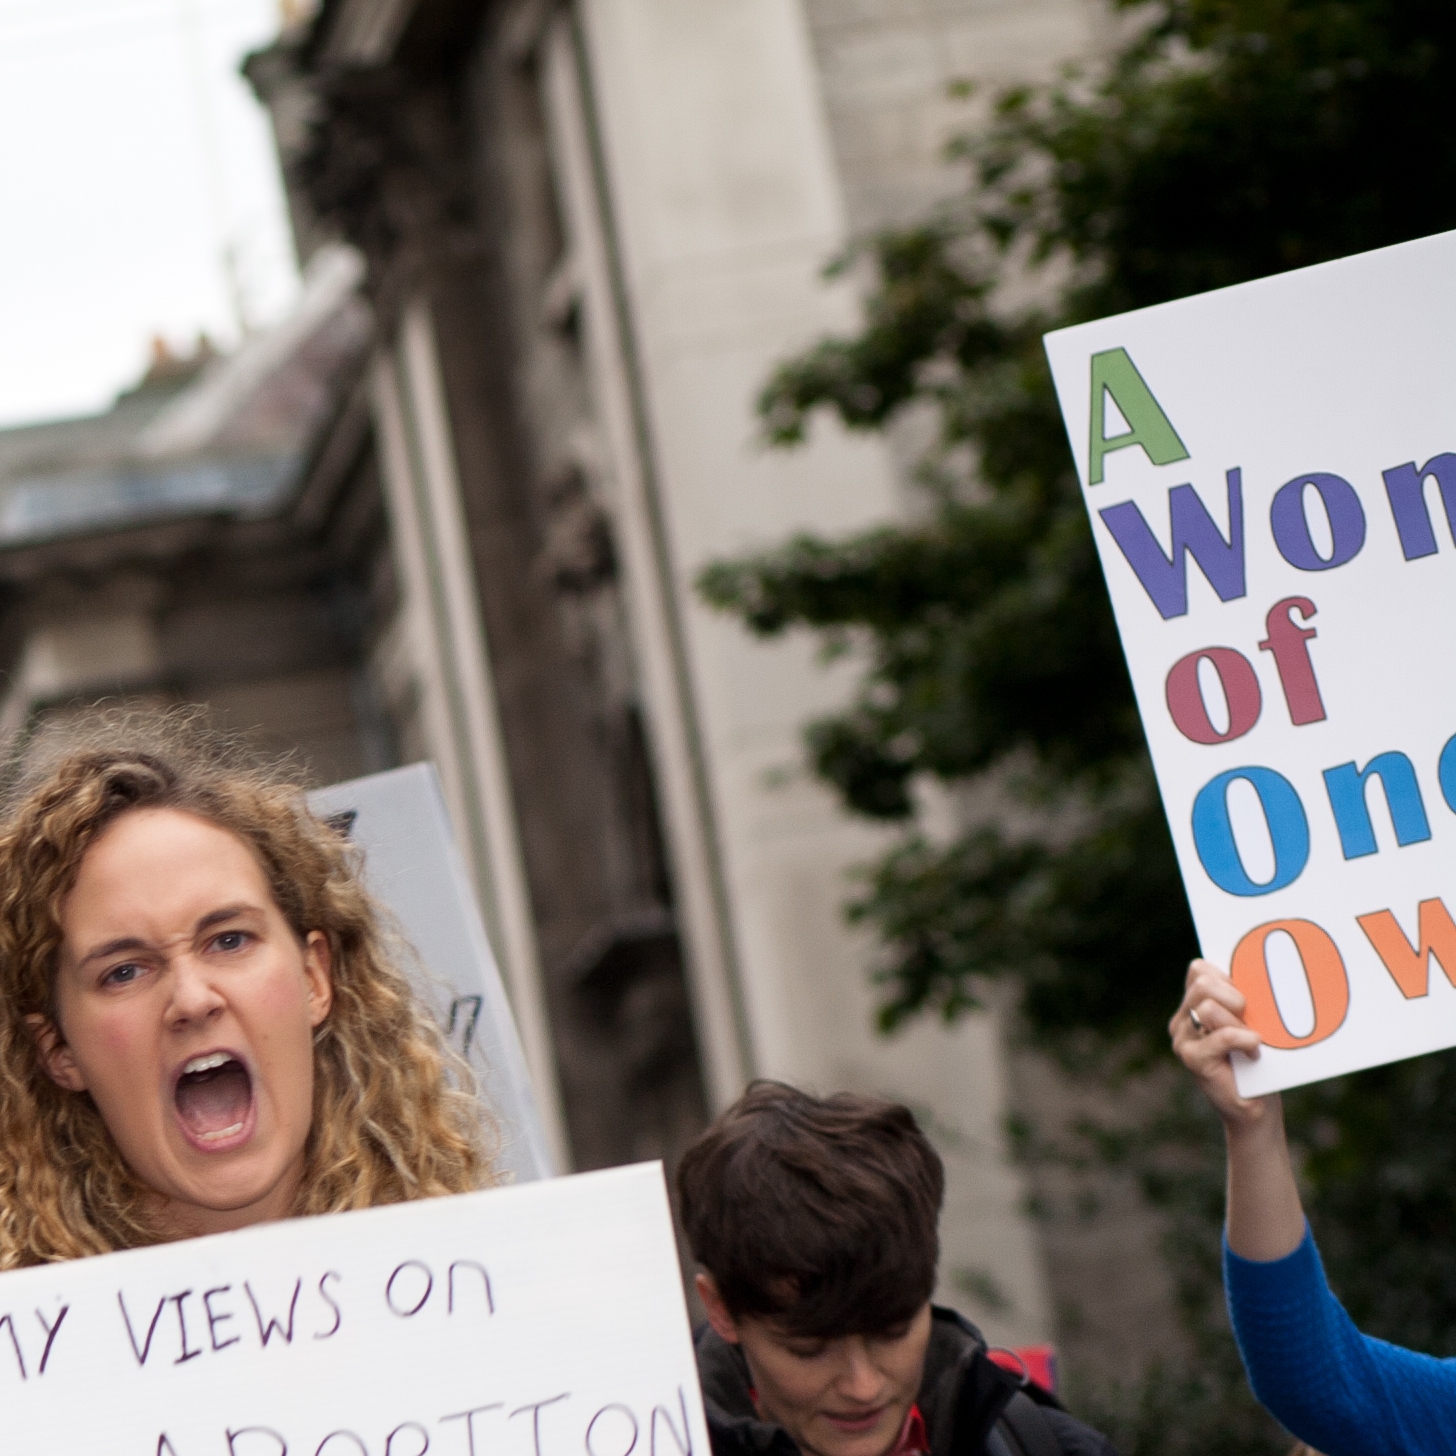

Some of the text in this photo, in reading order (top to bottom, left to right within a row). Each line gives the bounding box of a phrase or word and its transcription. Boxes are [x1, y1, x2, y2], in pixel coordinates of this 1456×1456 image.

[1089, 346, 1191, 486] A
[1165, 595, 1327, 745] of
[1191, 731, 1456, 897] On
[117, 1271, 341, 1367] VIEWS
